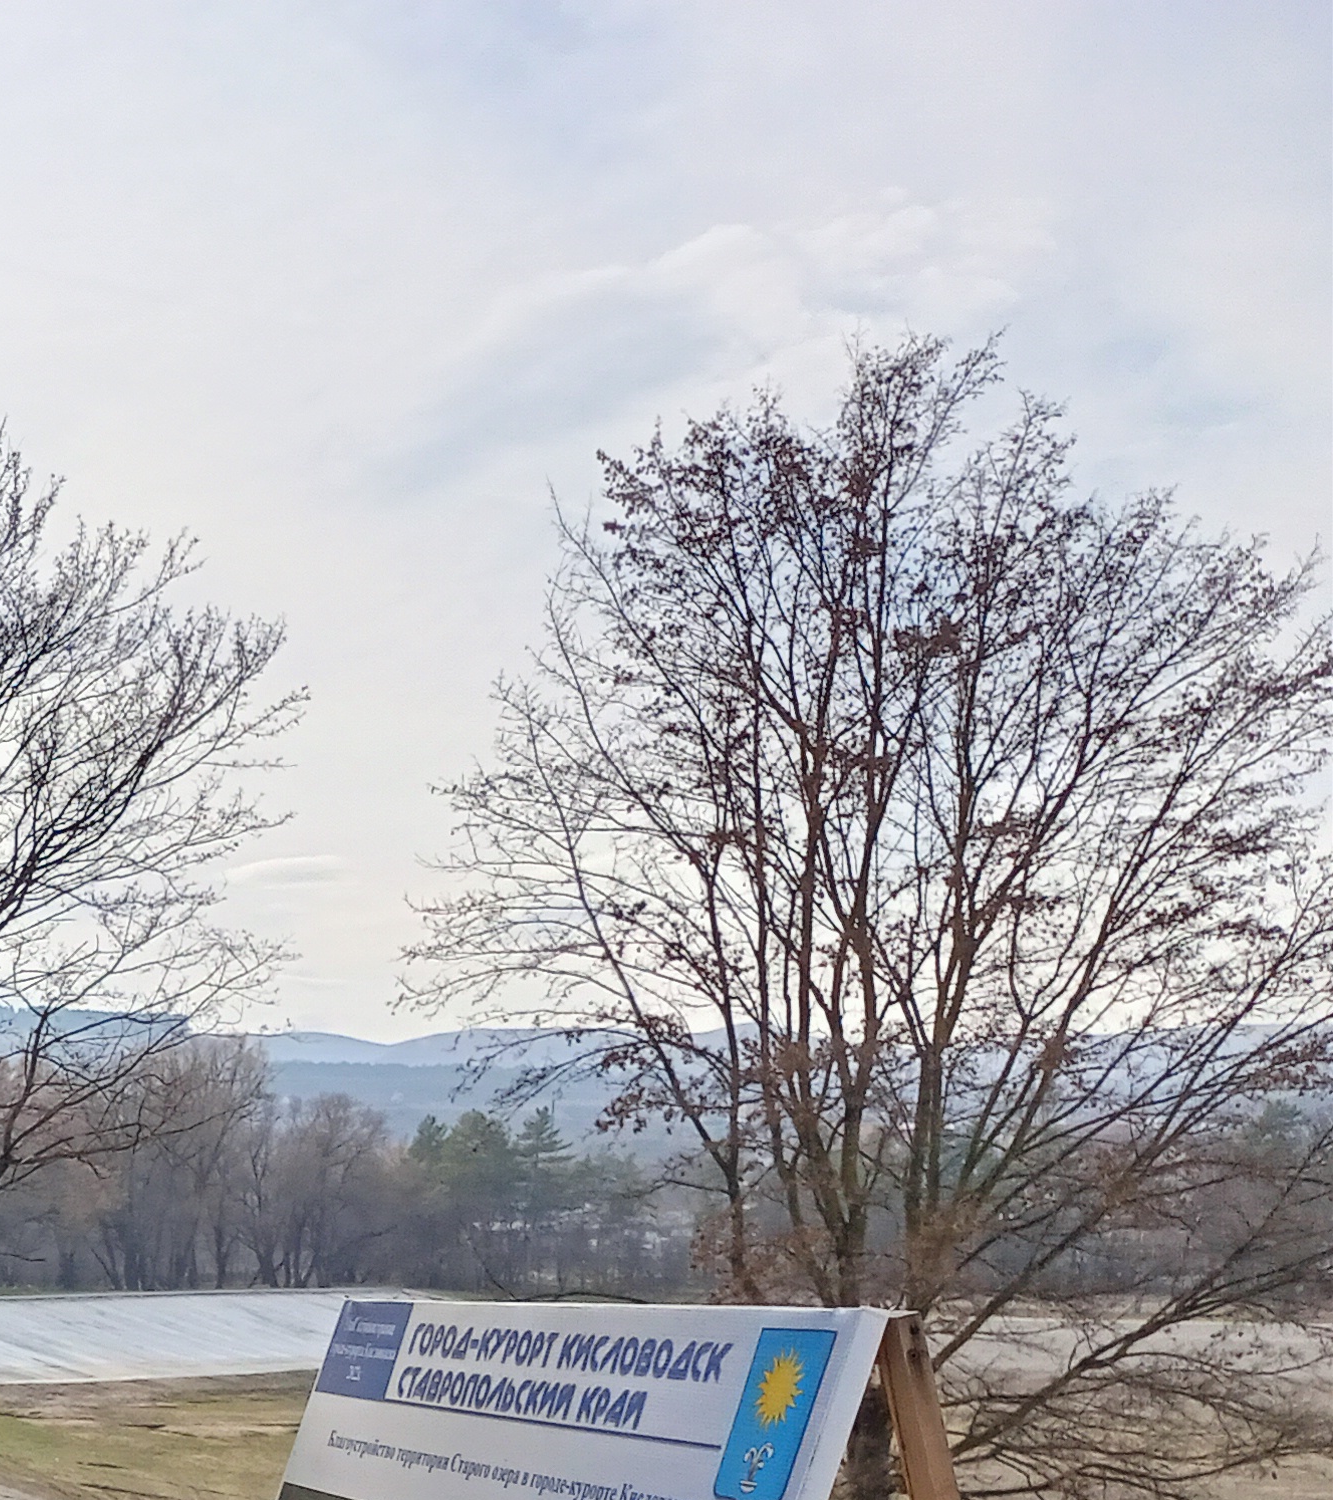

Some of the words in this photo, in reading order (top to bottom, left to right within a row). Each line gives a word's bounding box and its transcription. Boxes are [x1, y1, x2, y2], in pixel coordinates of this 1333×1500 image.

[408, 1323, 559, 1368] ГОРОД-КУРОРТ
[556, 1333, 734, 1383] КИСЛОВОДСК
[398, 1366, 576, 1420] СТАВРОПОЛЬСКИЙ
[576, 1386, 648, 1430] КРАЙ
[396, 1448, 450, 1474] территории
[450, 1453, 492, 1480] Старого
[491, 1465, 520, 1488] озера
[521, 1472, 530, 1486] в
